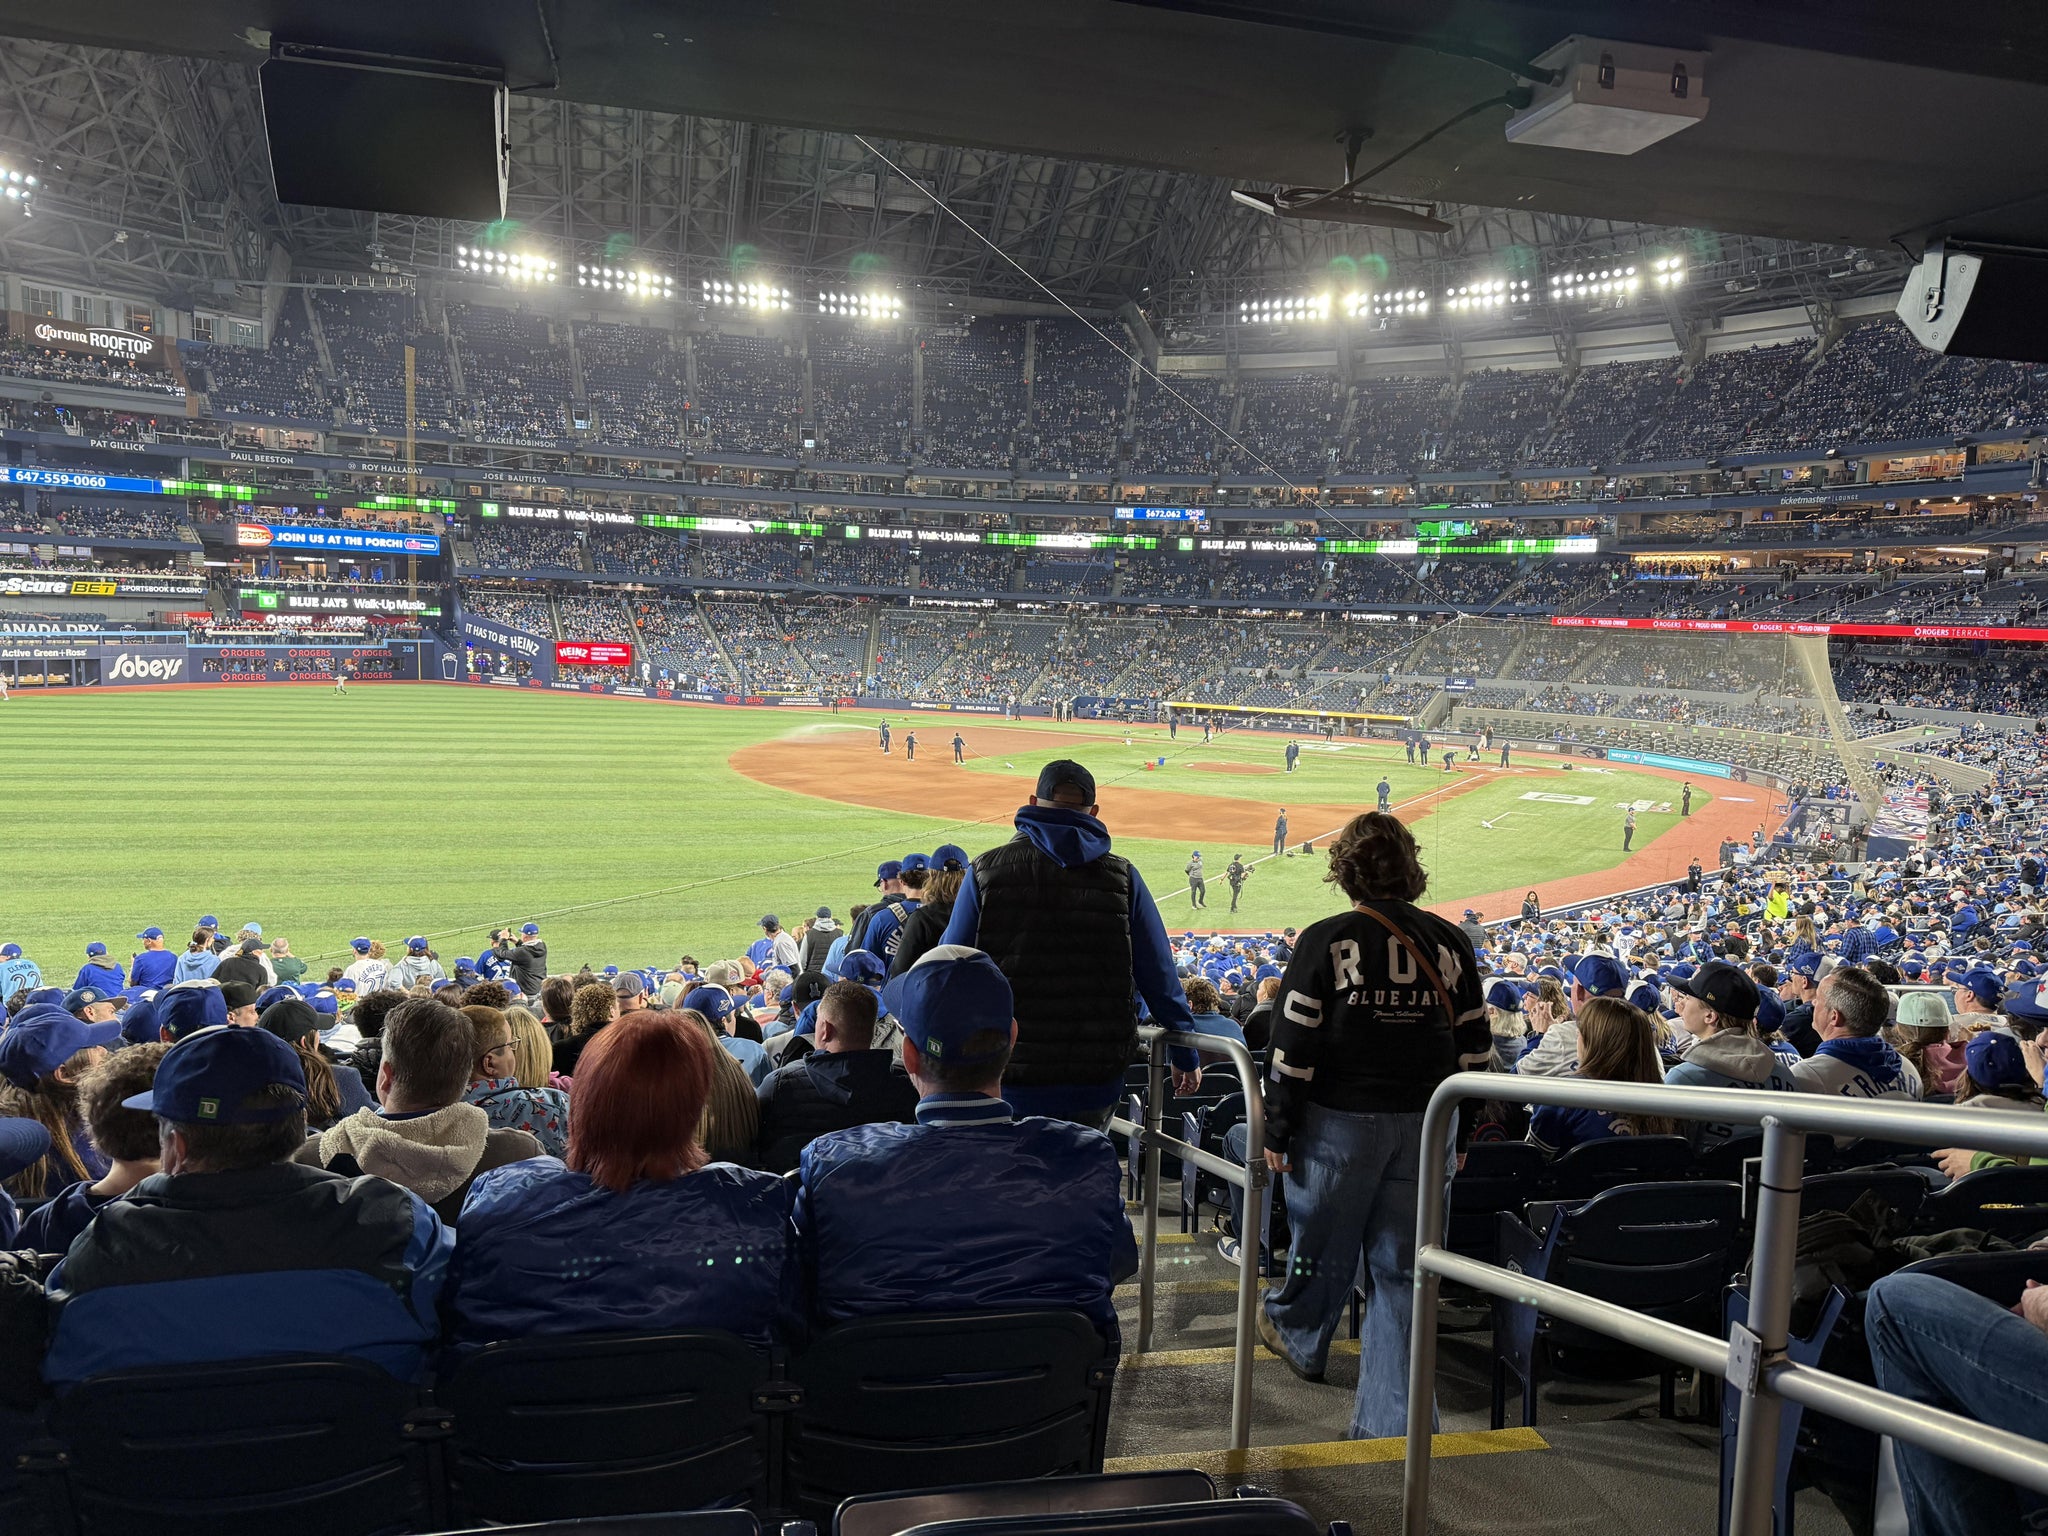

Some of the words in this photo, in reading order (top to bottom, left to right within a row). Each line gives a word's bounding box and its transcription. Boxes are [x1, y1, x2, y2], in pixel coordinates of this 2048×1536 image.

[35, 323, 88, 344] Corona
[90, 331, 153, 355] ROOFTOP
[108, 350, 136, 360] PATIO
[90, 439, 108, 449] PAT
[110, 441, 145, 452] GILLICK
[486, 436, 514, 446] JACKIE
[516, 438, 557, 448] ROBINSON
[230, 452, 253, 462] PAUL
[254, 454, 294, 465] BEESTON
[361, 463, 379, 472] ROY
[380, 464, 424, 475] HALLADAY
[15, 470, 107, 488] 647-559-0060
[507, 474, 548, 484] BAUTISTA
[1780, 496, 1828, 505] ticketmaster
[1835, 494, 1859, 502] LOUNGE
[508, 506, 534, 517] BLUE
[534, 508, 559, 519] JAYS
[564, 509, 605, 524] Walk-Up
[605, 512, 635, 524] Music
[1145, 509, 1181, 518] $672,062
[276, 532, 306, 543] JOIN
[308, 534, 325, 544] US
[327, 535, 341, 545] AT
[344, 536, 363, 546] THE
[868, 528, 891, 538] BLUE
[891, 529, 913, 539] JAYS
[917, 530, 954, 542] Walk-Up
[954, 532, 980, 542] Music
[1201, 540, 1224, 550] BLUE
[1224, 540, 1247, 550] JAYS
[1251, 540, 1289, 552] Walk-Up
[1289, 541, 1317, 551] Music
[73, 583, 116, 594] BET
[121, 585, 169, 593] SPORTSBOOK
[262, 595, 275, 605] TD
[289, 596, 320, 608] BLUE
[321, 597, 349, 609] JAYS
[353, 598, 396, 612] Walk-Up
[396, 600, 427, 611] Music
[276, 615, 313, 625] ROGERS
[329, 615, 366, 626] LANDING
[1922, 628, 1949, 637] ROGERS
[1951, 628, 1990, 638] TERRACE
[465, 622, 473, 634] IT
[473, 624, 488, 639] HAS
[488, 629, 498, 642] TO
[498, 633, 508, 646] BE
[510, 635, 540, 657] HEINZ
[1, 649, 31, 657] Active
[230, 649, 266, 657] ROGERS
[298, 649, 331, 657] ROGERS
[361, 649, 393, 657] ROGERS
[402, 645, 415, 653] 328
[558, 646, 589, 658] HEINZ
[108, 652, 183, 681] Sobeys
[231, 672, 267, 681] ROGERS
[298, 672, 332, 680] ROGERS
[362, 671, 393, 679] ROGERS
[1347, 990, 1400, 1005] BLUE
[1407, 990, 1445, 1005] JAY
[930, 1040, 940, 1053] TD
[200, 1101, 217, 1114] TD
